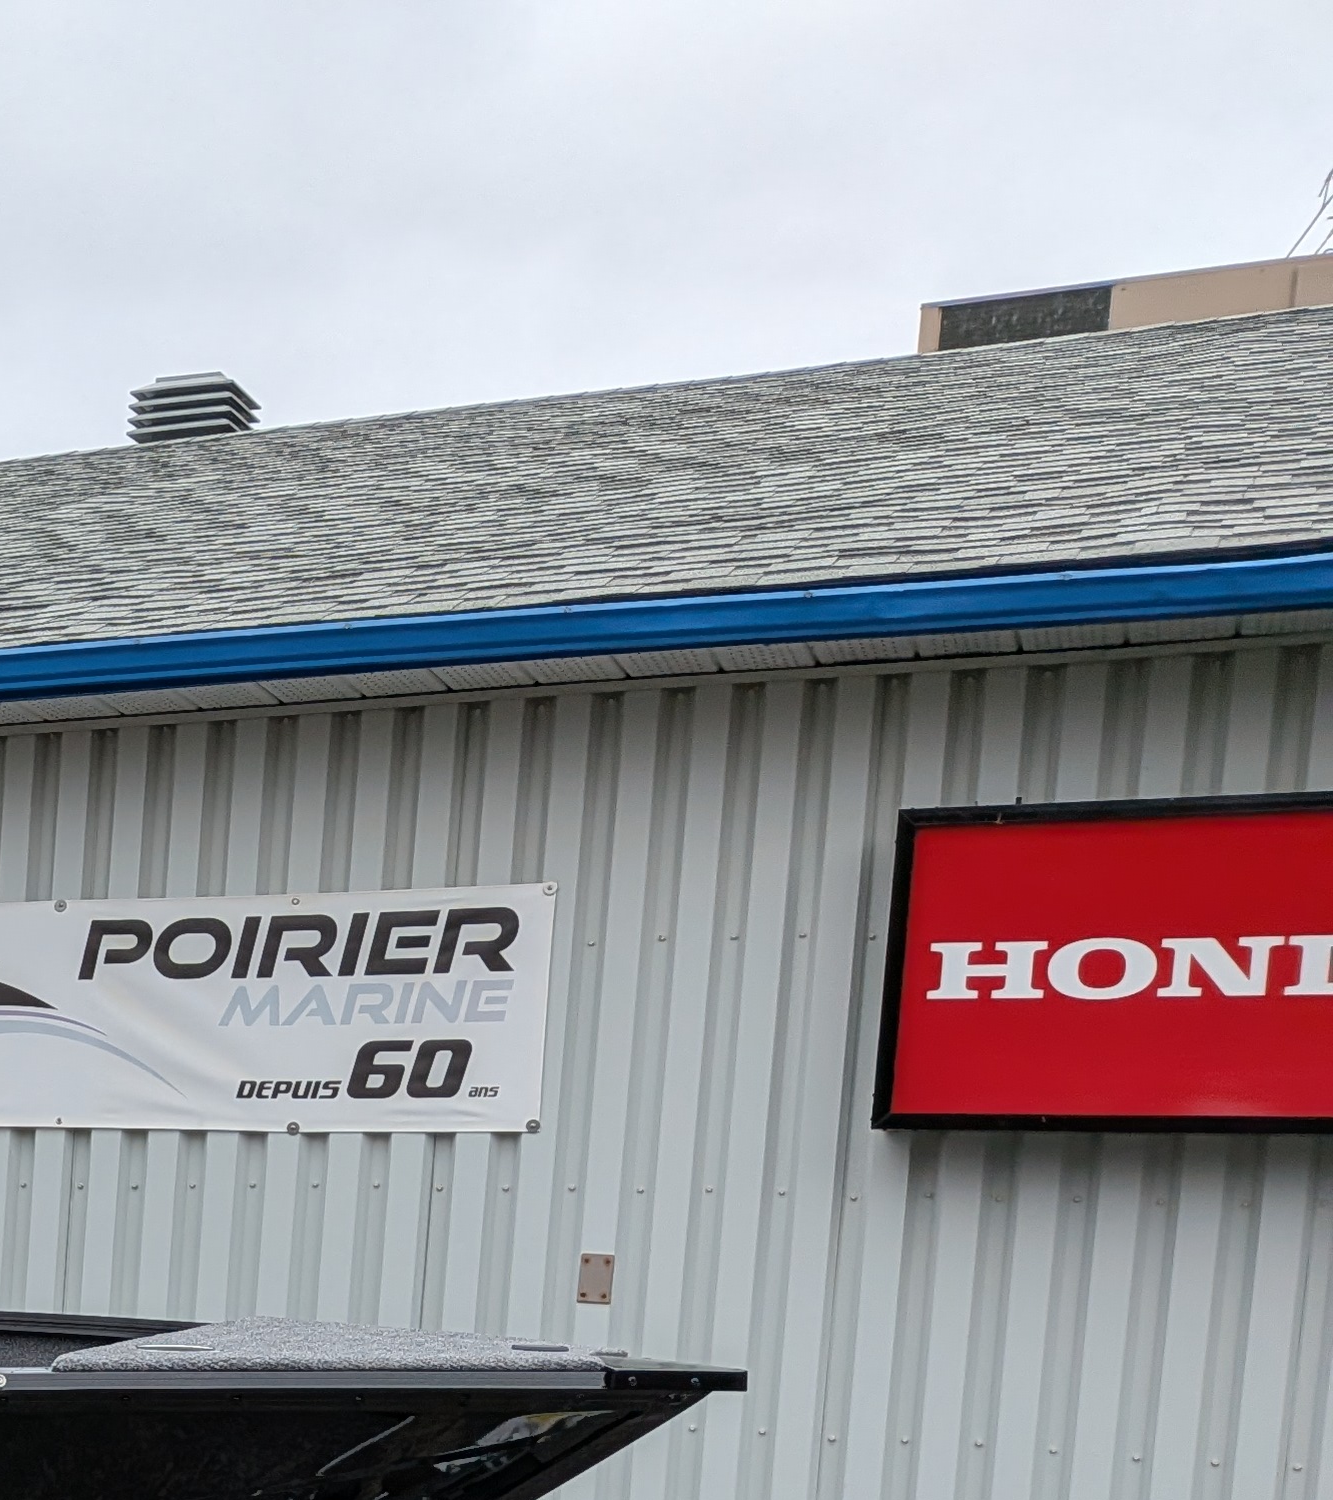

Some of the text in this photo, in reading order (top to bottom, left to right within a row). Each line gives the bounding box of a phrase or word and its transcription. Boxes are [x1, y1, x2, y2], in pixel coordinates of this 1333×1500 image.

[78, 905, 521, 981] POIRIER
[217, 979, 514, 1027] MARINE
[235, 1039, 500, 1100] DEPUIS 60 ans
